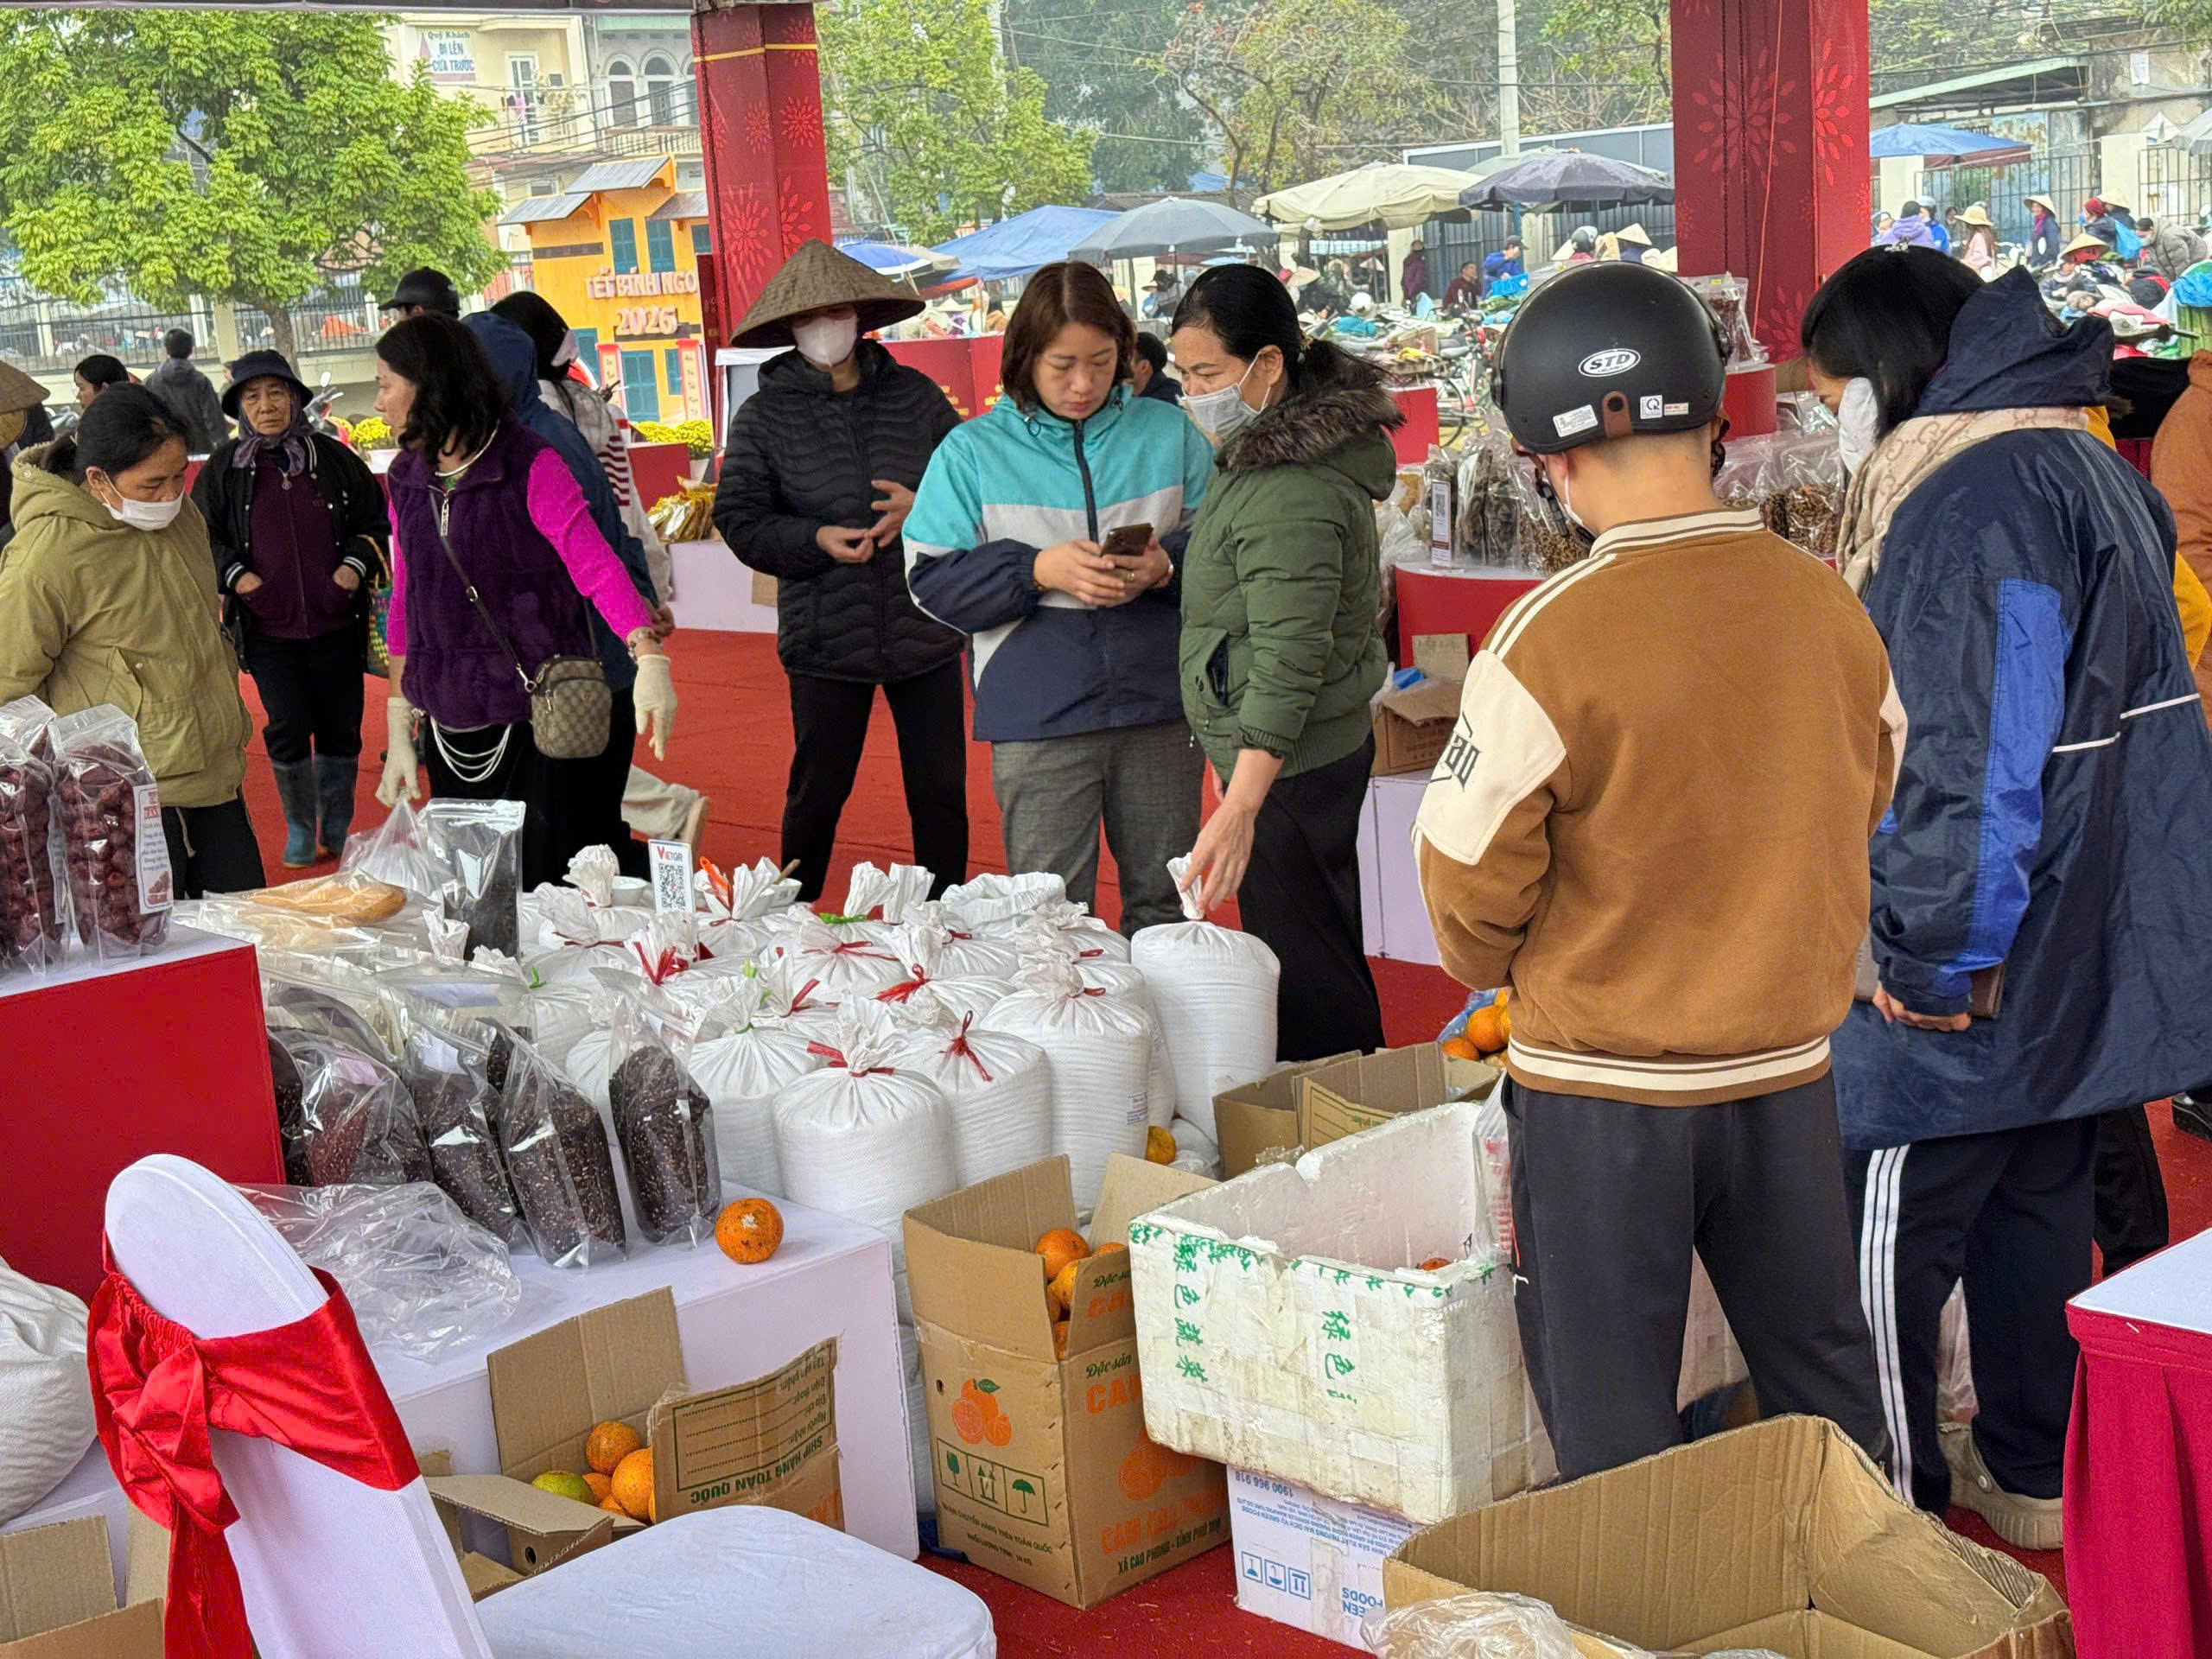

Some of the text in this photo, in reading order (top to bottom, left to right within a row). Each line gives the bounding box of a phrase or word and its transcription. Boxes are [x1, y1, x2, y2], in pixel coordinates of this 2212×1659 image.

[614, 306, 678, 336] 2026
[1589, 353, 1630, 370] STD
[803, 1435, 823, 1459] SHIP
[690, 1482, 731, 1507] QUỐC
[1234, 1471, 1294, 1498] 1900 966 918
[1129, 1551, 1145, 1568] CAO
